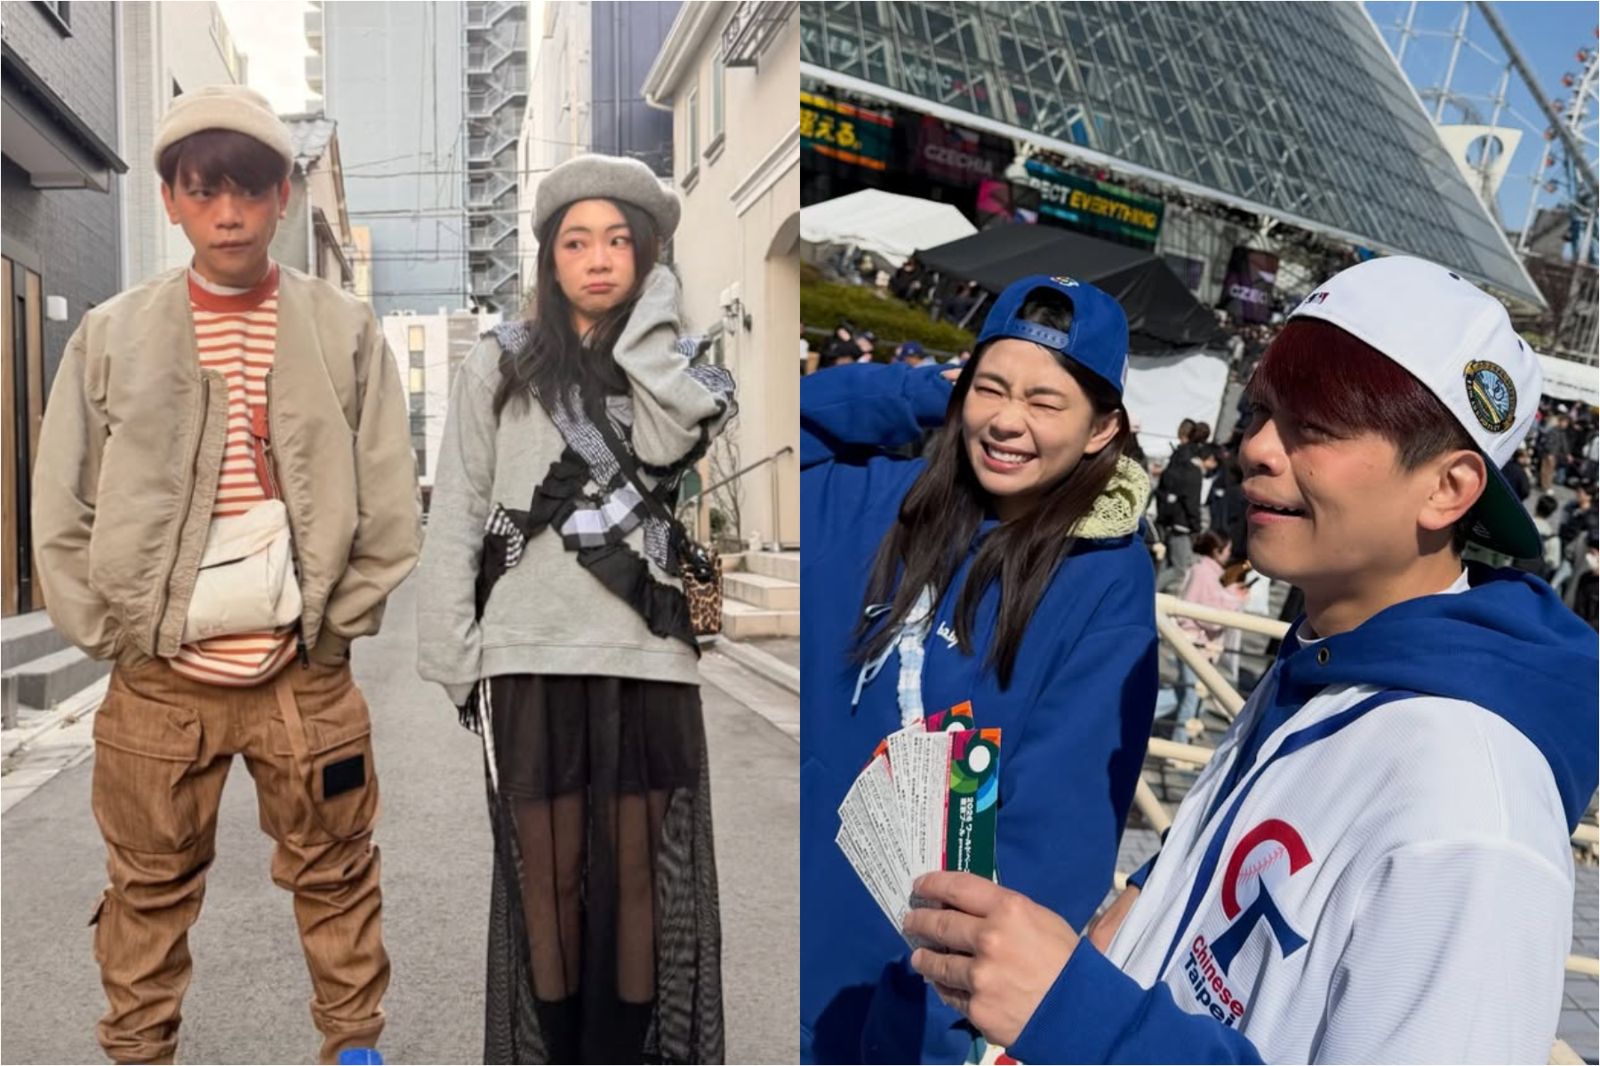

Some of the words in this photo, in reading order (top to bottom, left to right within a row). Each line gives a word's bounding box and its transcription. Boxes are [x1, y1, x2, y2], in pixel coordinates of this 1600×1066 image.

[924, 144, 993, 175] CZECHIA
[1070, 189, 1157, 229] EVERYTHING
[966, 797, 974, 822] 2026
[1184, 952, 1235, 1028] Taipei
[1192, 934, 1245, 1017] Chinese
